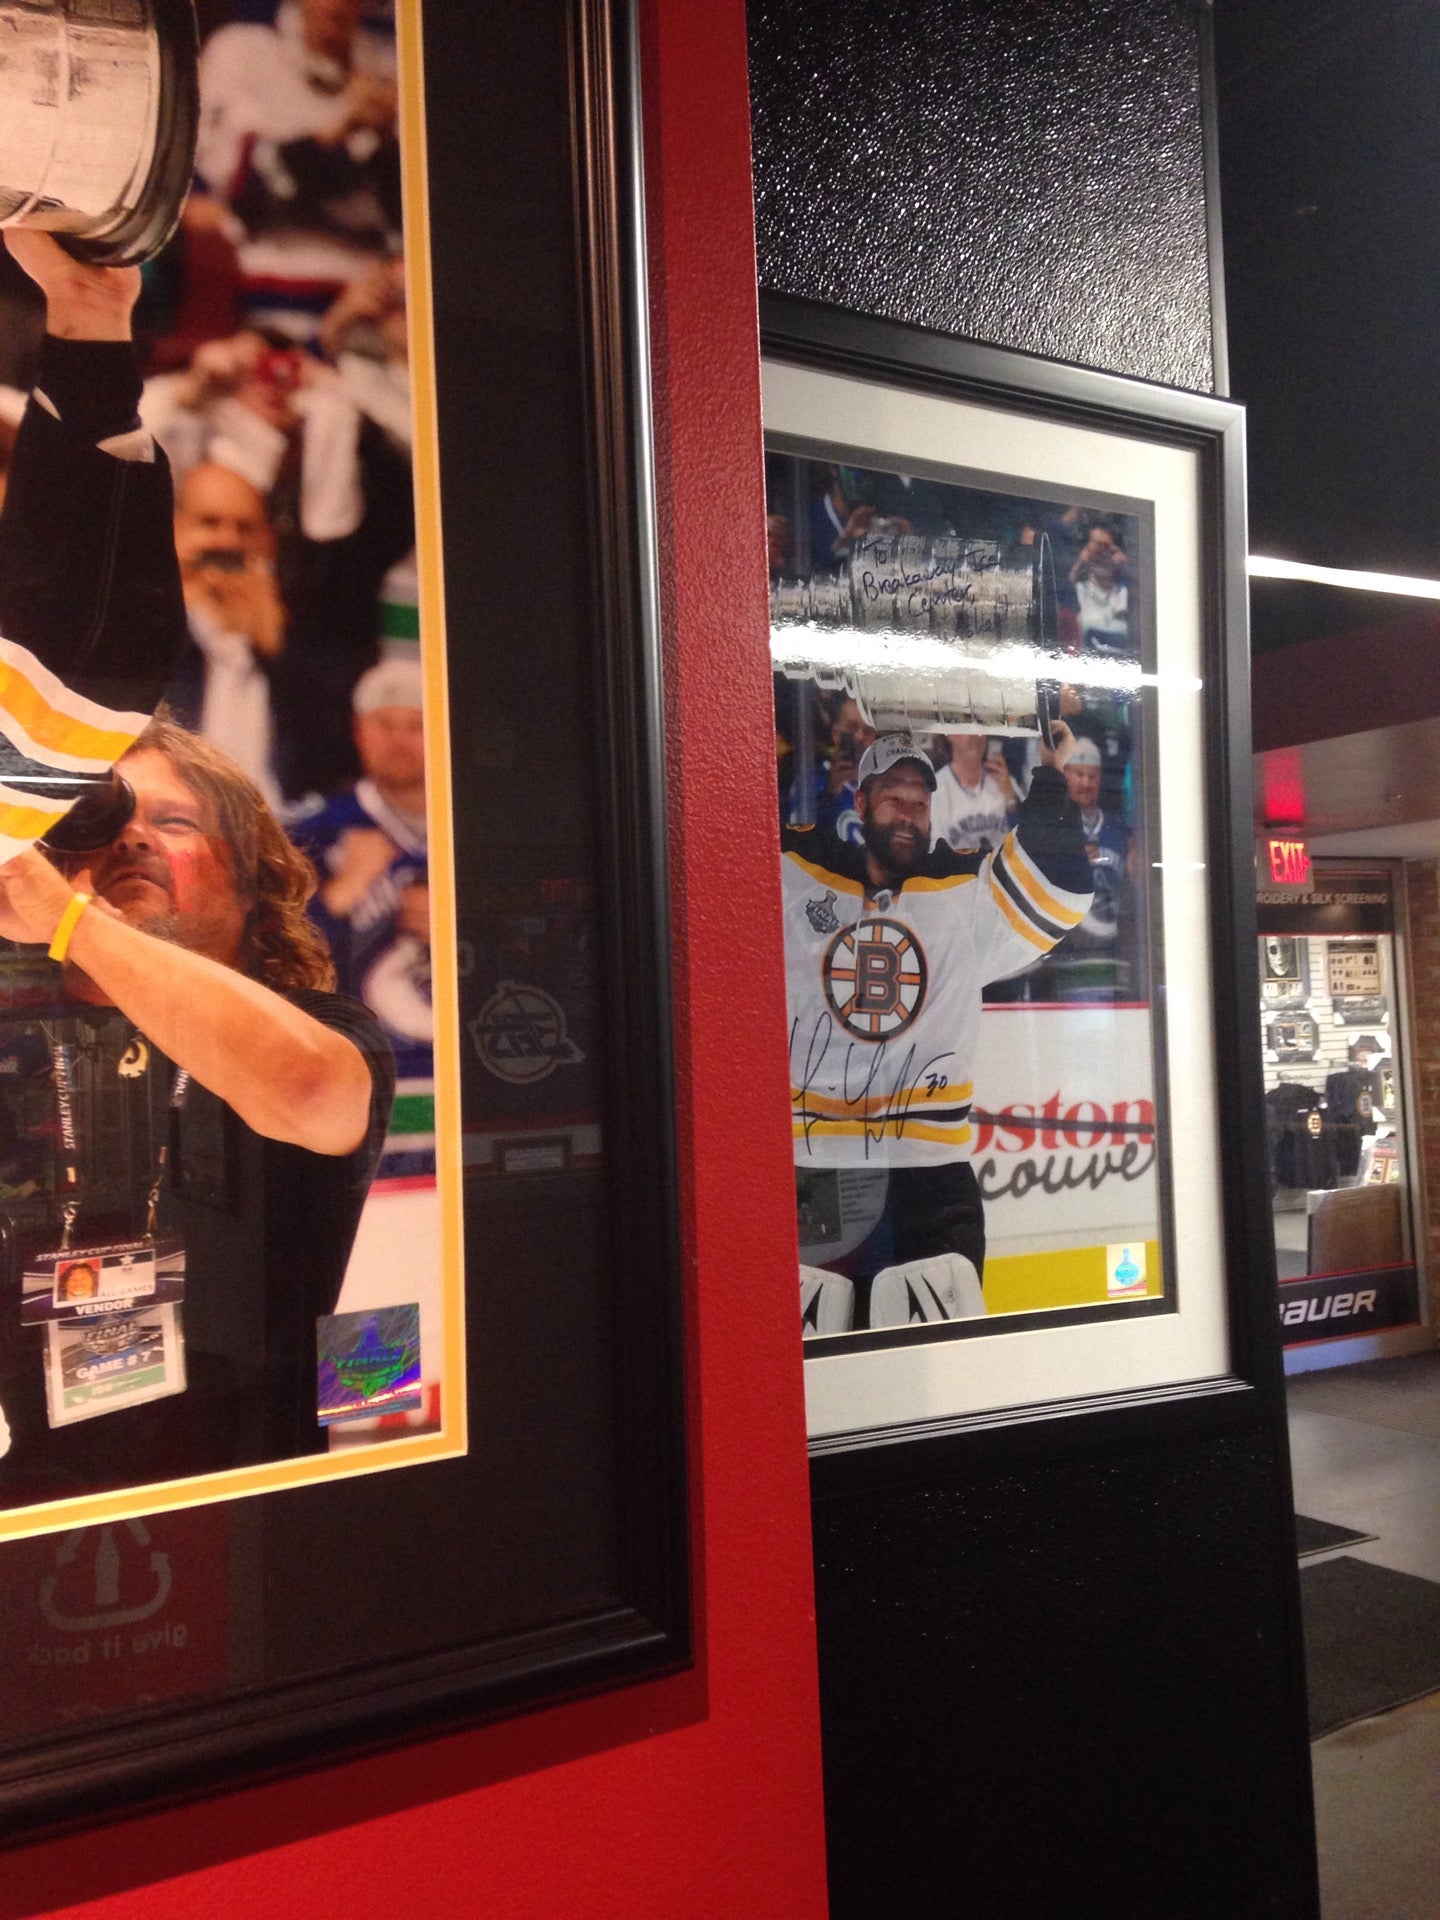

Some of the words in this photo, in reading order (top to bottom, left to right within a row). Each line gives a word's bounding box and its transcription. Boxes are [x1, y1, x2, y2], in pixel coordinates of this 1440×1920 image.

[863, 539, 888, 567] To
[862, 560, 956, 601] Breakaway
[1269, 841, 1307, 884] EXIT
[808, 901, 840, 928] FINAL
[852, 941, 902, 1015] B
[58, 1100, 76, 1149] STANLEY
[35, 1250, 87, 1262] STANLEY
[75, 1298, 134, 1316] VENDOR
[75, 1358, 124, 1380] GAME
[140, 1351, 152, 1363] 7
